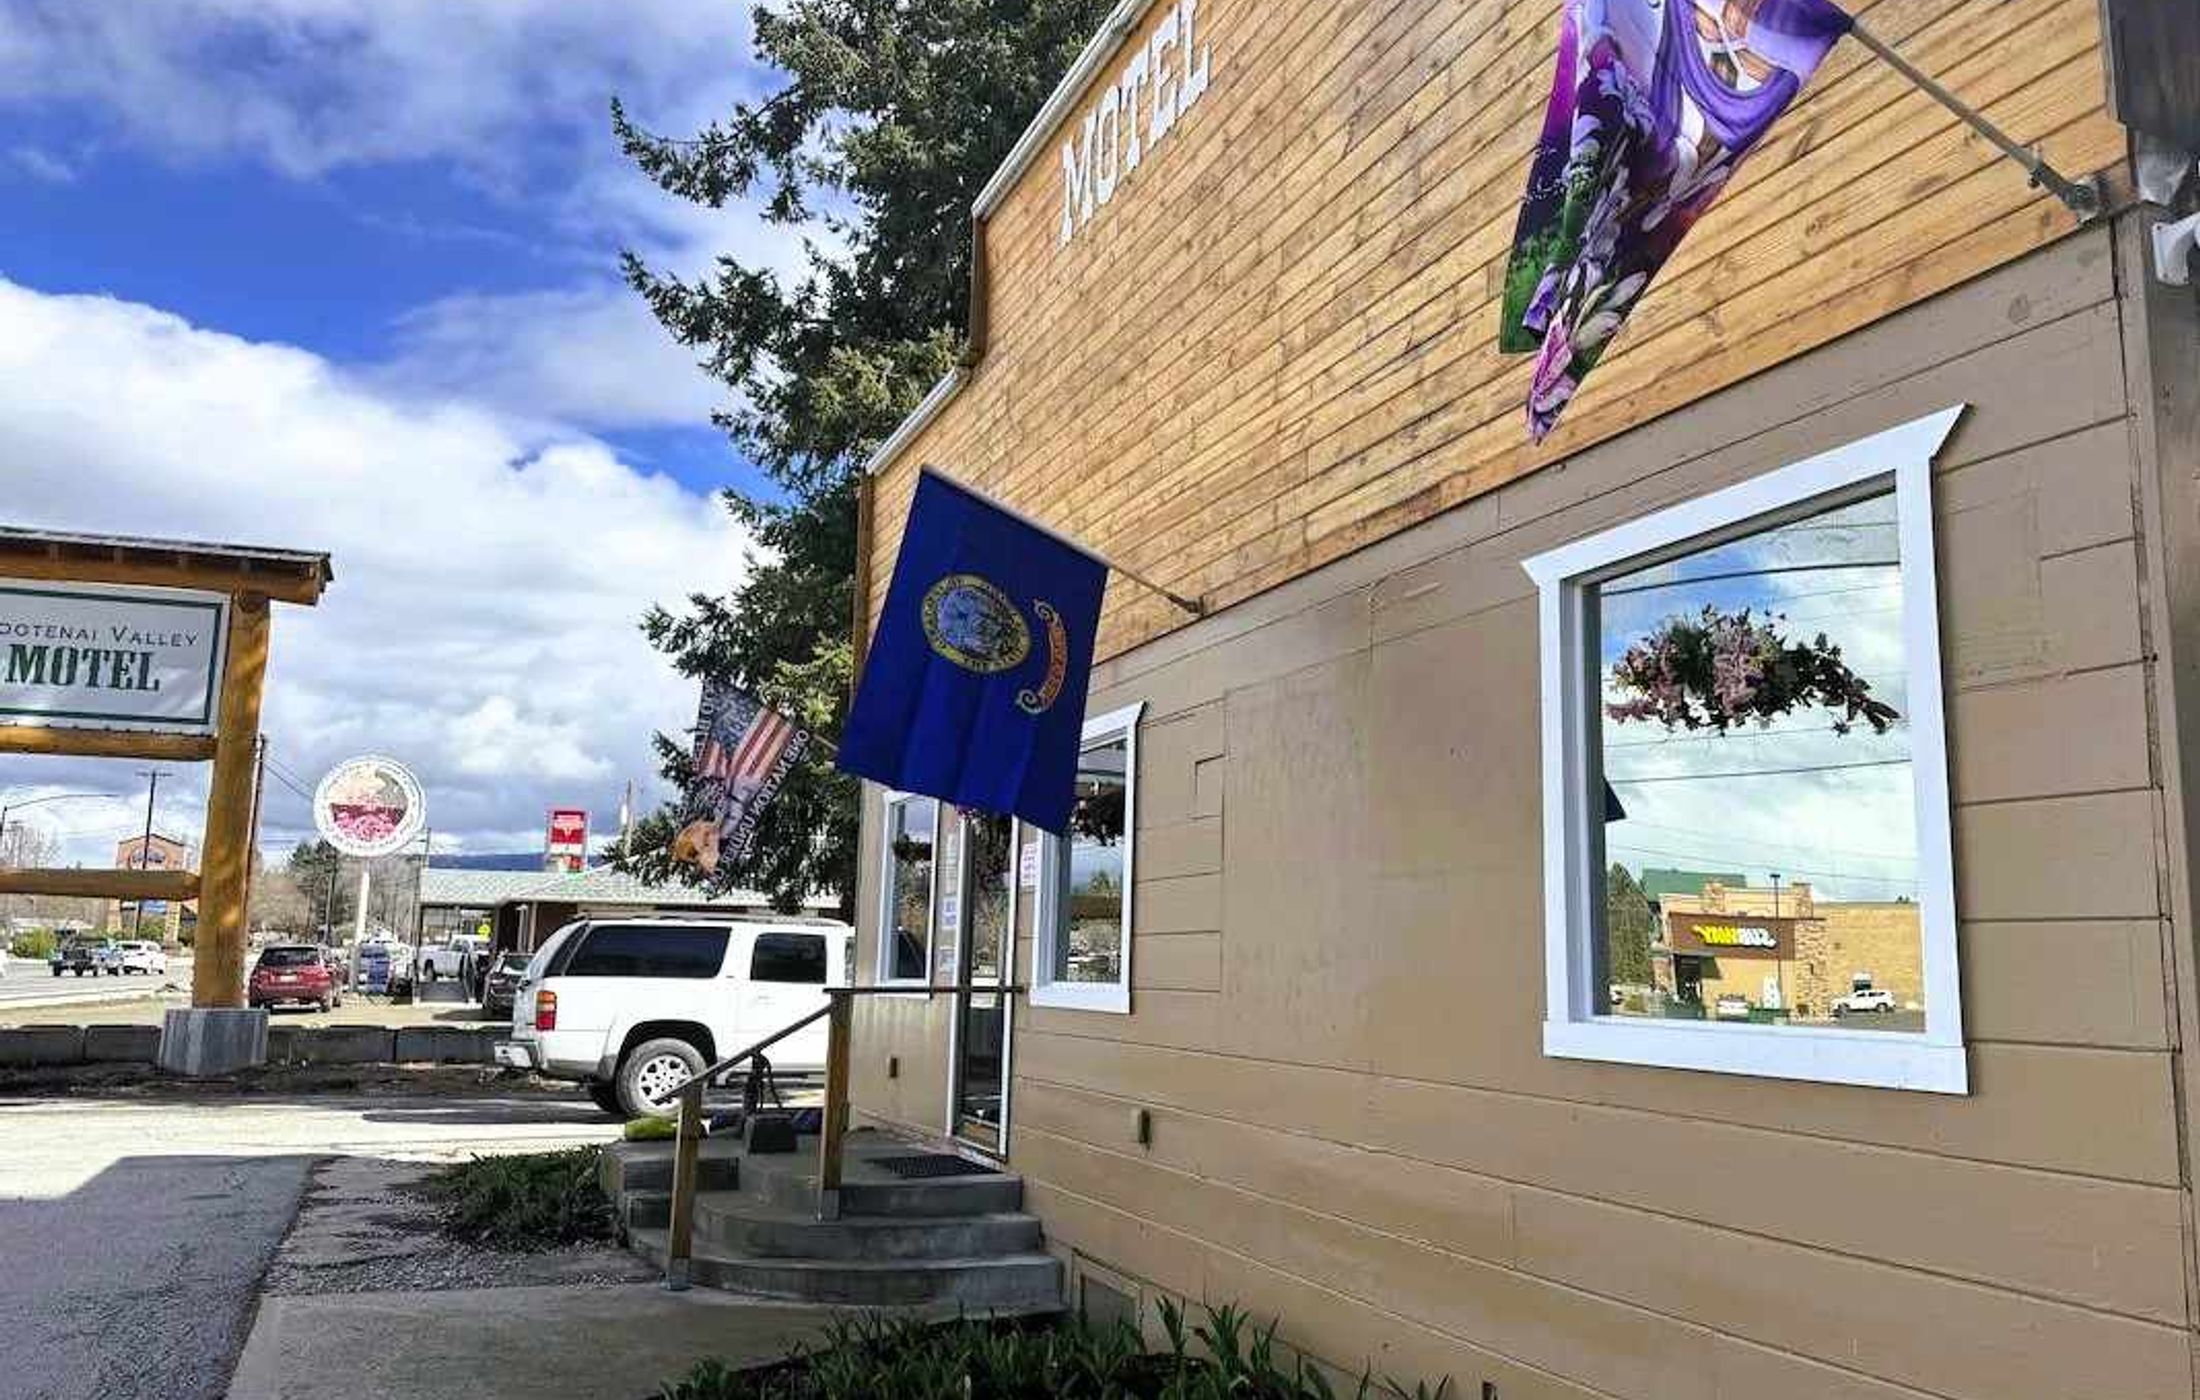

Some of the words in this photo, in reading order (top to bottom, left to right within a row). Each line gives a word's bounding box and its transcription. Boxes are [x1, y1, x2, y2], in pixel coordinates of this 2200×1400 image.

[1060, 0, 1211, 246] MOTEL
[111, 626, 199, 648] VALLEY
[5, 643, 160, 691] MOTEL
